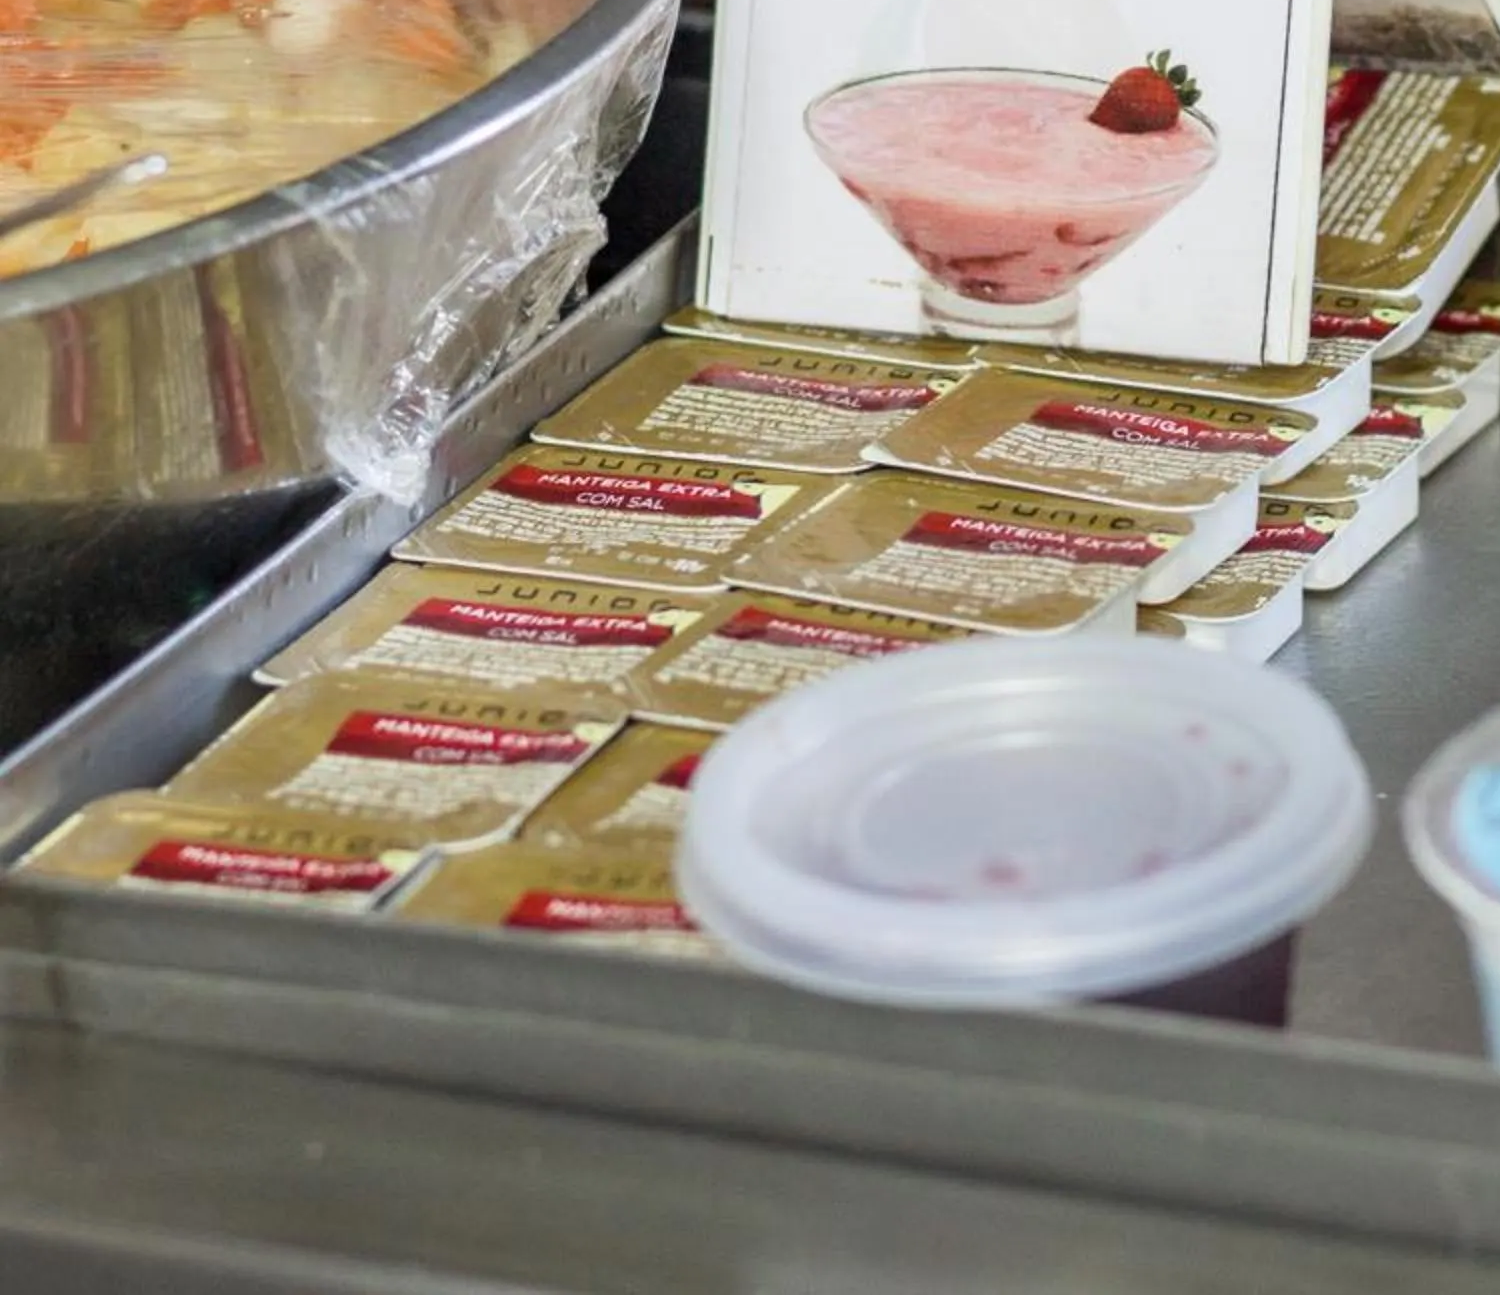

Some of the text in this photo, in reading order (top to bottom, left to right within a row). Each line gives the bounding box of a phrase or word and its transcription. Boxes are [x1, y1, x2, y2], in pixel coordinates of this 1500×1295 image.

[774, 386, 862, 409] COM SAL
[1073, 404, 1269, 442] MANTEIGA EXTRA
[1111, 426, 1201, 450] COM SAL
[537, 473, 732, 499] MANTEIGA EXTRA
[575, 491, 665, 511] COM SAL
[950, 517, 1147, 551] MANTEIGA EXTRA
[988, 539, 1037, 552] COM
[449, 604, 648, 632] MANTEIGA EXTRA
[488, 626, 579, 645] COM SAL
[402, 700, 602, 725] JUNIO
[373, 718, 495, 746] MANTEIGA
